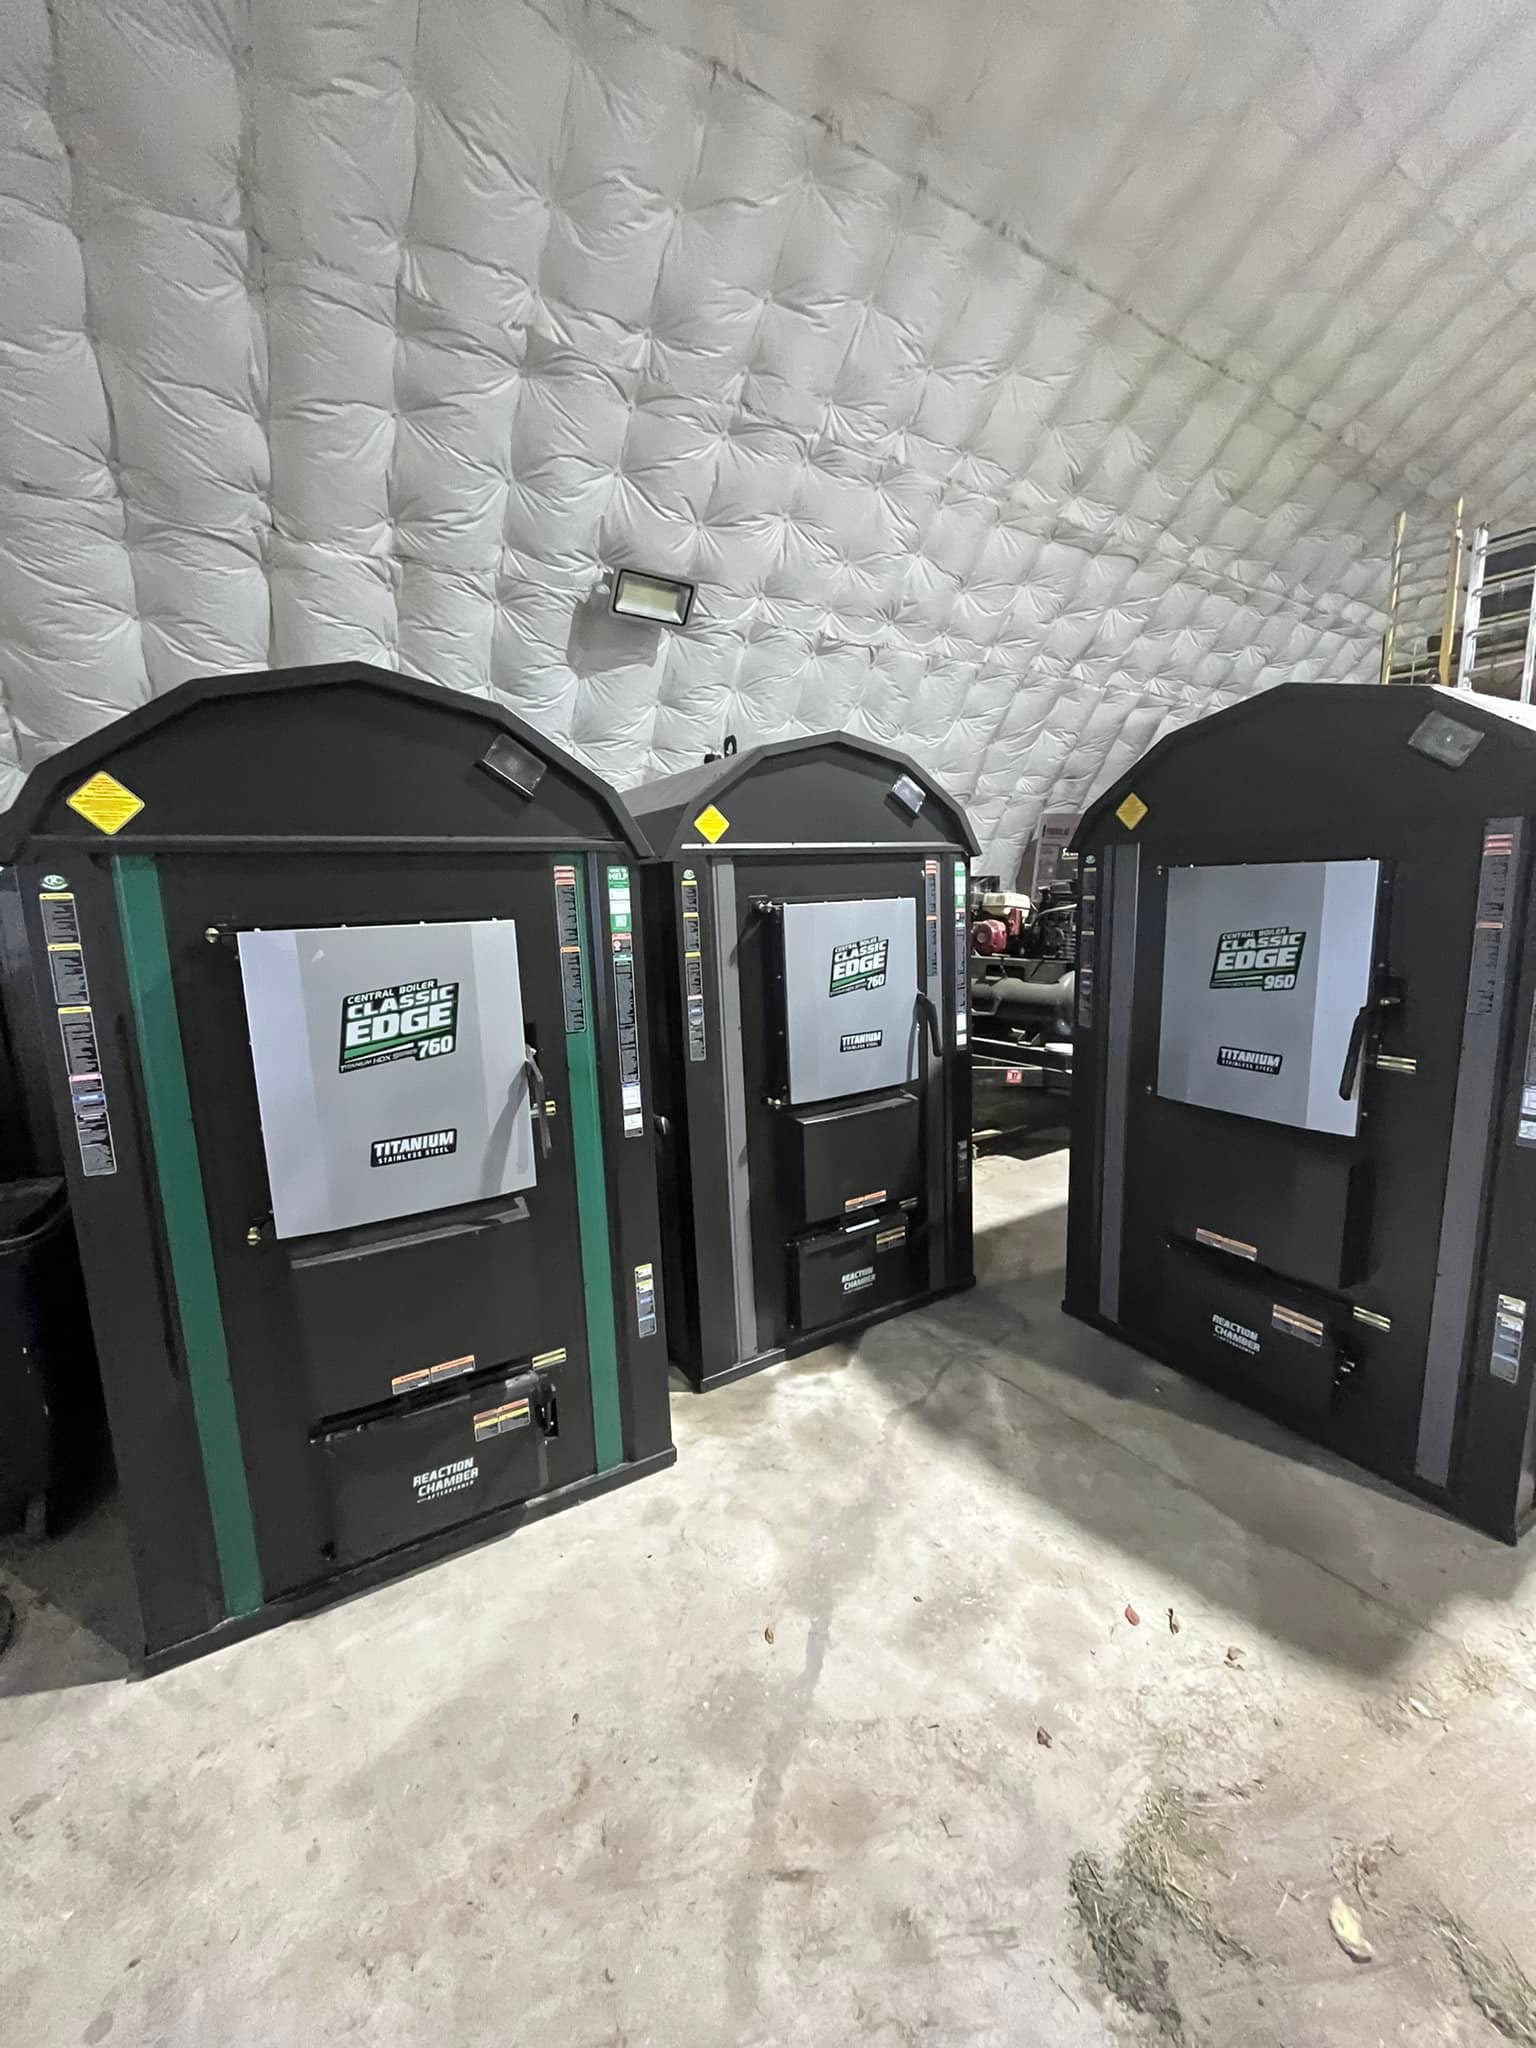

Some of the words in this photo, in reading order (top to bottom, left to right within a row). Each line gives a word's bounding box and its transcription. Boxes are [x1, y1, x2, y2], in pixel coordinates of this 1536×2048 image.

[1221, 933, 1302, 951] CLASSIC
[1222, 931, 1255, 940] CENTRAL
[1259, 927, 1287, 937] BOILER
[834, 941, 887, 962] CLASSIC
[1216, 946, 1298, 971] EDGE
[833, 951, 886, 981] EDGE
[347, 988, 394, 1005] CENTRAL
[399, 980, 435, 994] BOILER
[867, 973, 884, 989] 760
[1263, 974, 1296, 990] 960
[347, 985, 455, 1019] CLASSIC
[345, 1001, 453, 1047] EDGE
[417, 1035, 454, 1059] 760
[842, 1031, 882, 1046] TITANIUM
[1221, 1048, 1280, 1067] TITANIUM
[1221, 1059, 1254, 1070] STAINLESS
[374, 1131, 455, 1157] TITANIUM
[378, 1151, 422, 1164] STAINLESS
[425, 1147, 449, 1156] STEEL
[1212, 1314, 1258, 1341] REACTION
[1214, 1325, 1261, 1353] CHAMBER
[412, 1456, 474, 1488] REACTION
[418, 1467, 479, 1497] CHAMBER
